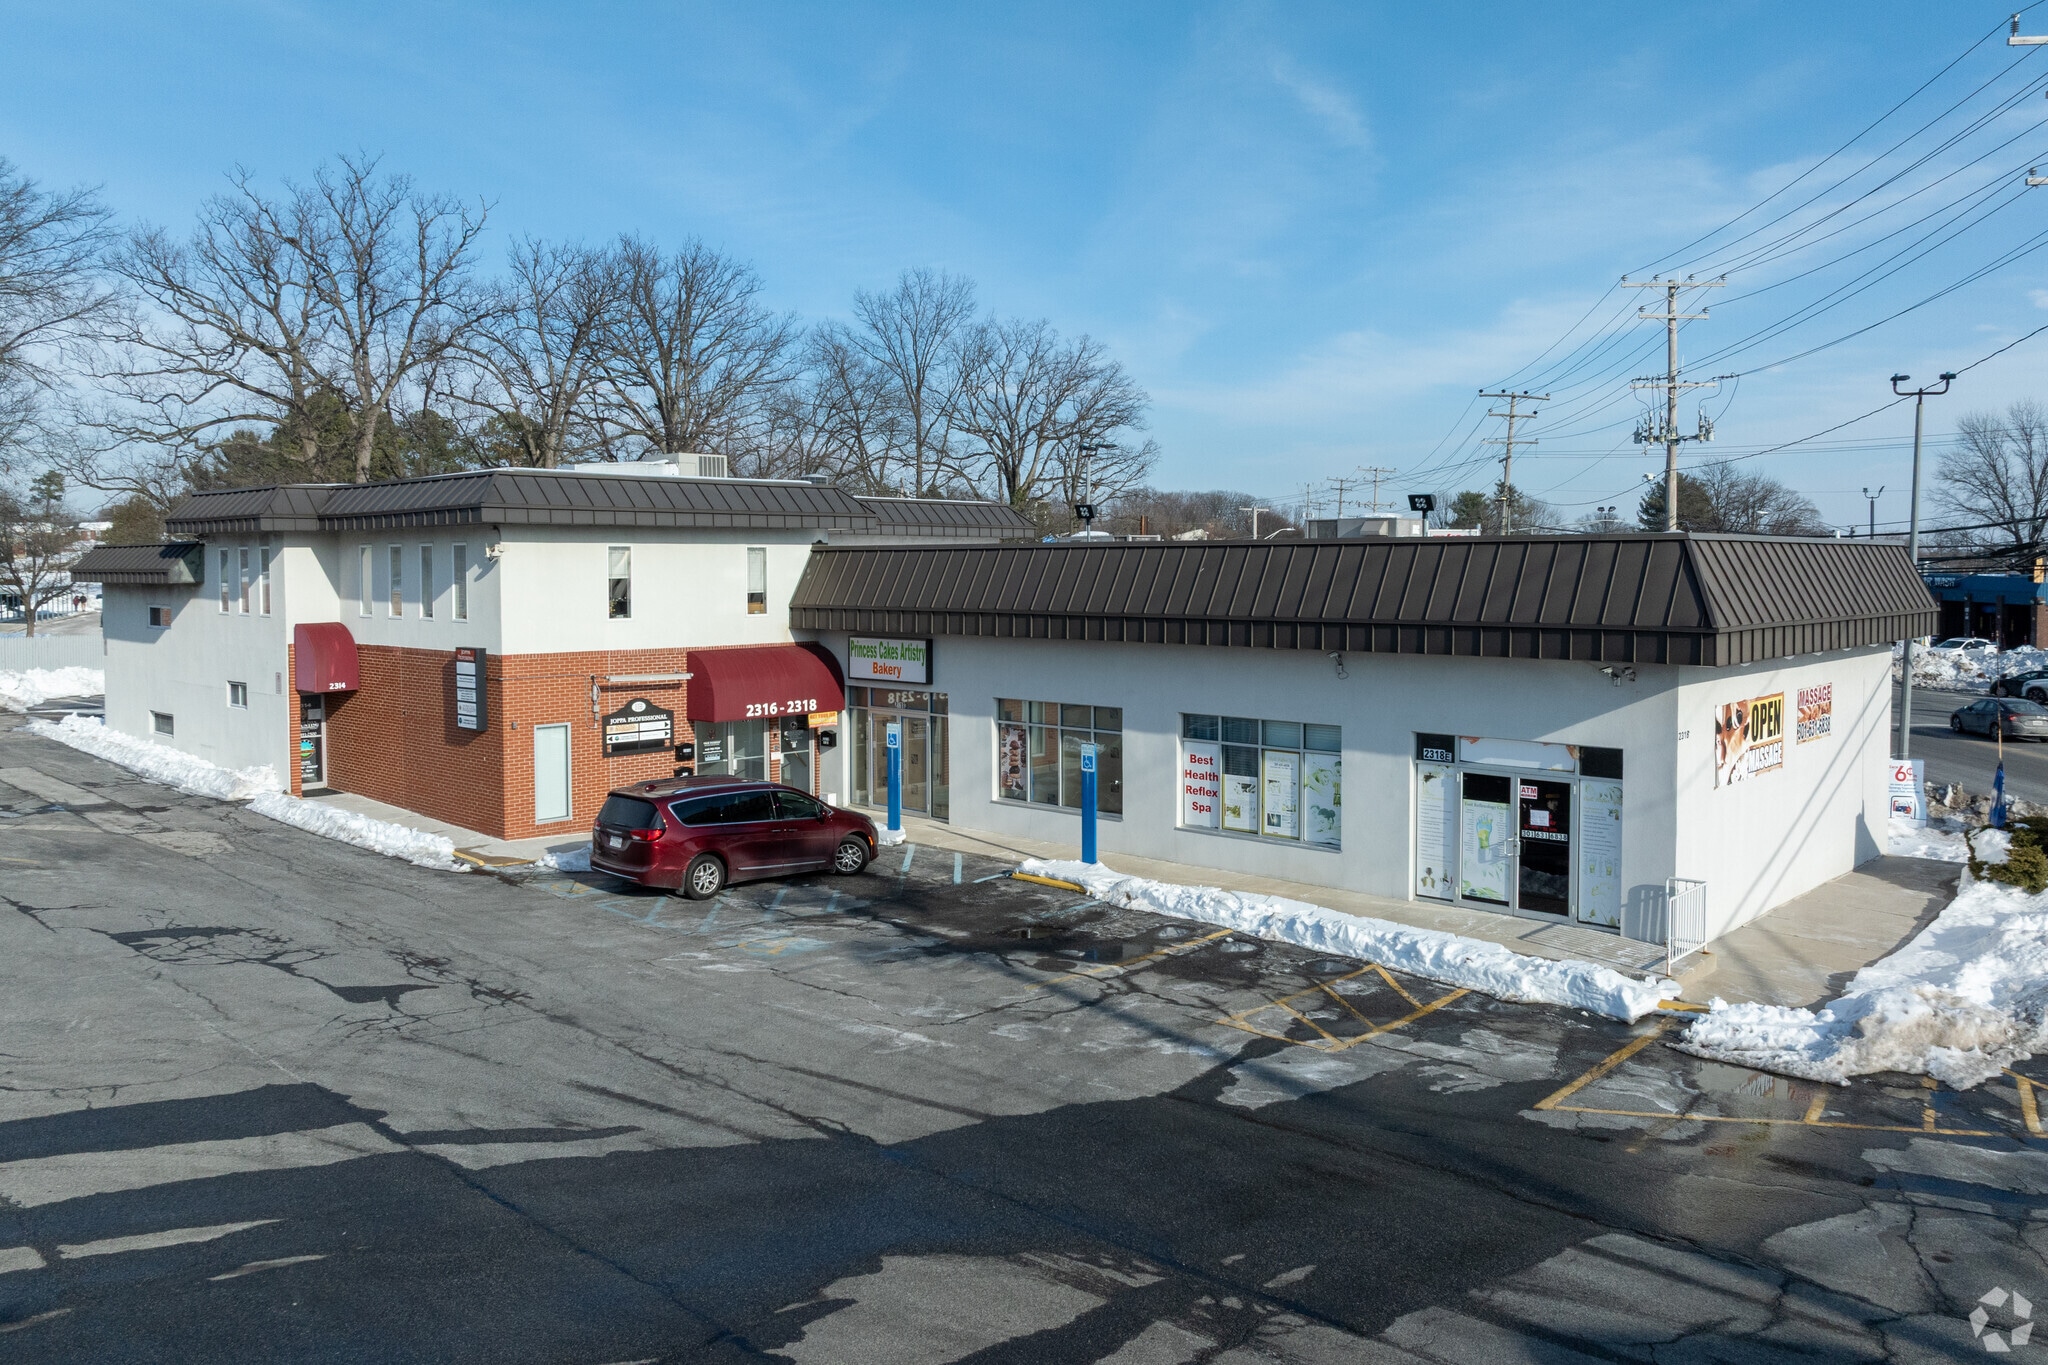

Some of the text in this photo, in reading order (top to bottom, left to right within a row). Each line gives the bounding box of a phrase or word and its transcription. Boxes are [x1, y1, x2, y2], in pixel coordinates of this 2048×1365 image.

[850, 639, 926, 666] Princess Cakes Artistry
[872, 662, 902, 678] Bakery
[329, 682, 346, 690] 2314
[1799, 685, 1831, 707] MASSAGE
[746, 702, 778, 717] 2316
[787, 699, 817, 713] 2318
[628, 714, 668, 723] PROFESSIONAL
[1751, 699, 1782, 742] OPEN
[1189, 754, 1214, 766] Best
[1748, 741, 1783, 773] MASSAGE
[1184, 769, 1219, 782] Health
[1185, 785, 1218, 798] Reflex
[1521, 786, 1537, 794] ATM
[1192, 801, 1212, 814] Spa
